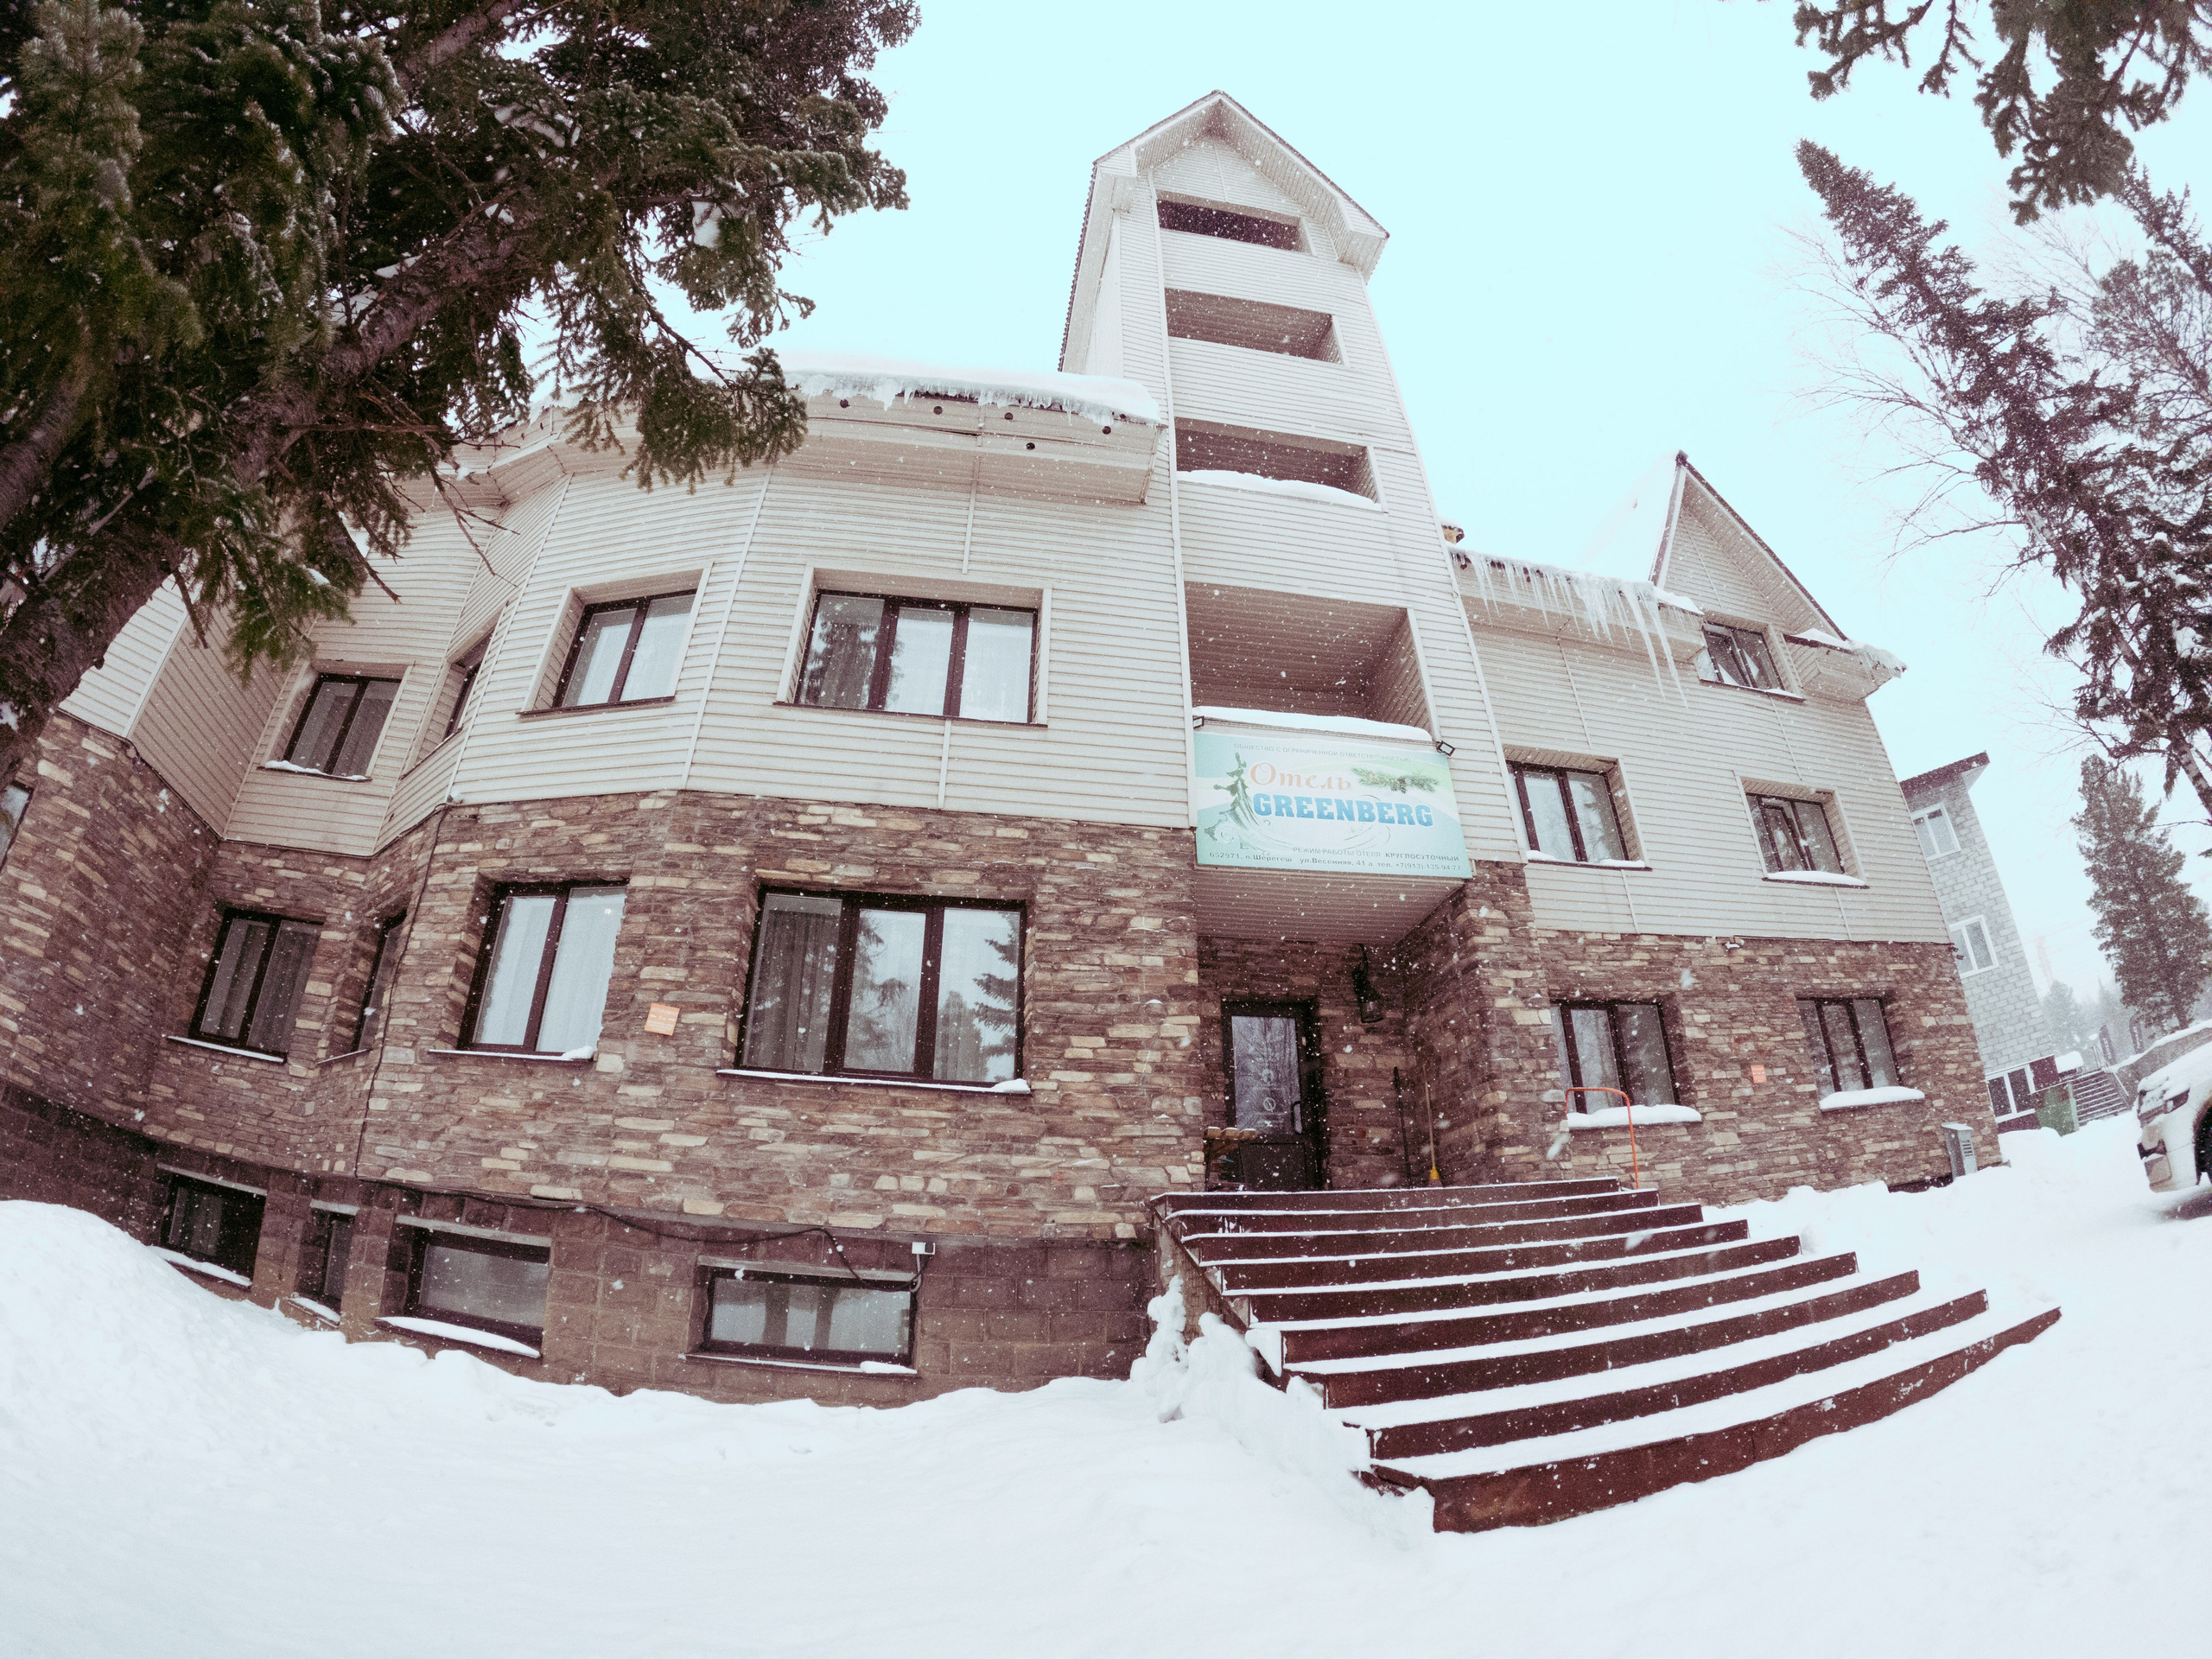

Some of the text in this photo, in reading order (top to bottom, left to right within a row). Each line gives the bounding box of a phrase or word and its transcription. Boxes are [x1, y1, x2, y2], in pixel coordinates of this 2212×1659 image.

[1234, 743, 1274, 752] ОБЩЕСТВО
[1250, 762, 1351, 791] Отель
[1253, 792, 1433, 827] GREENBERG
